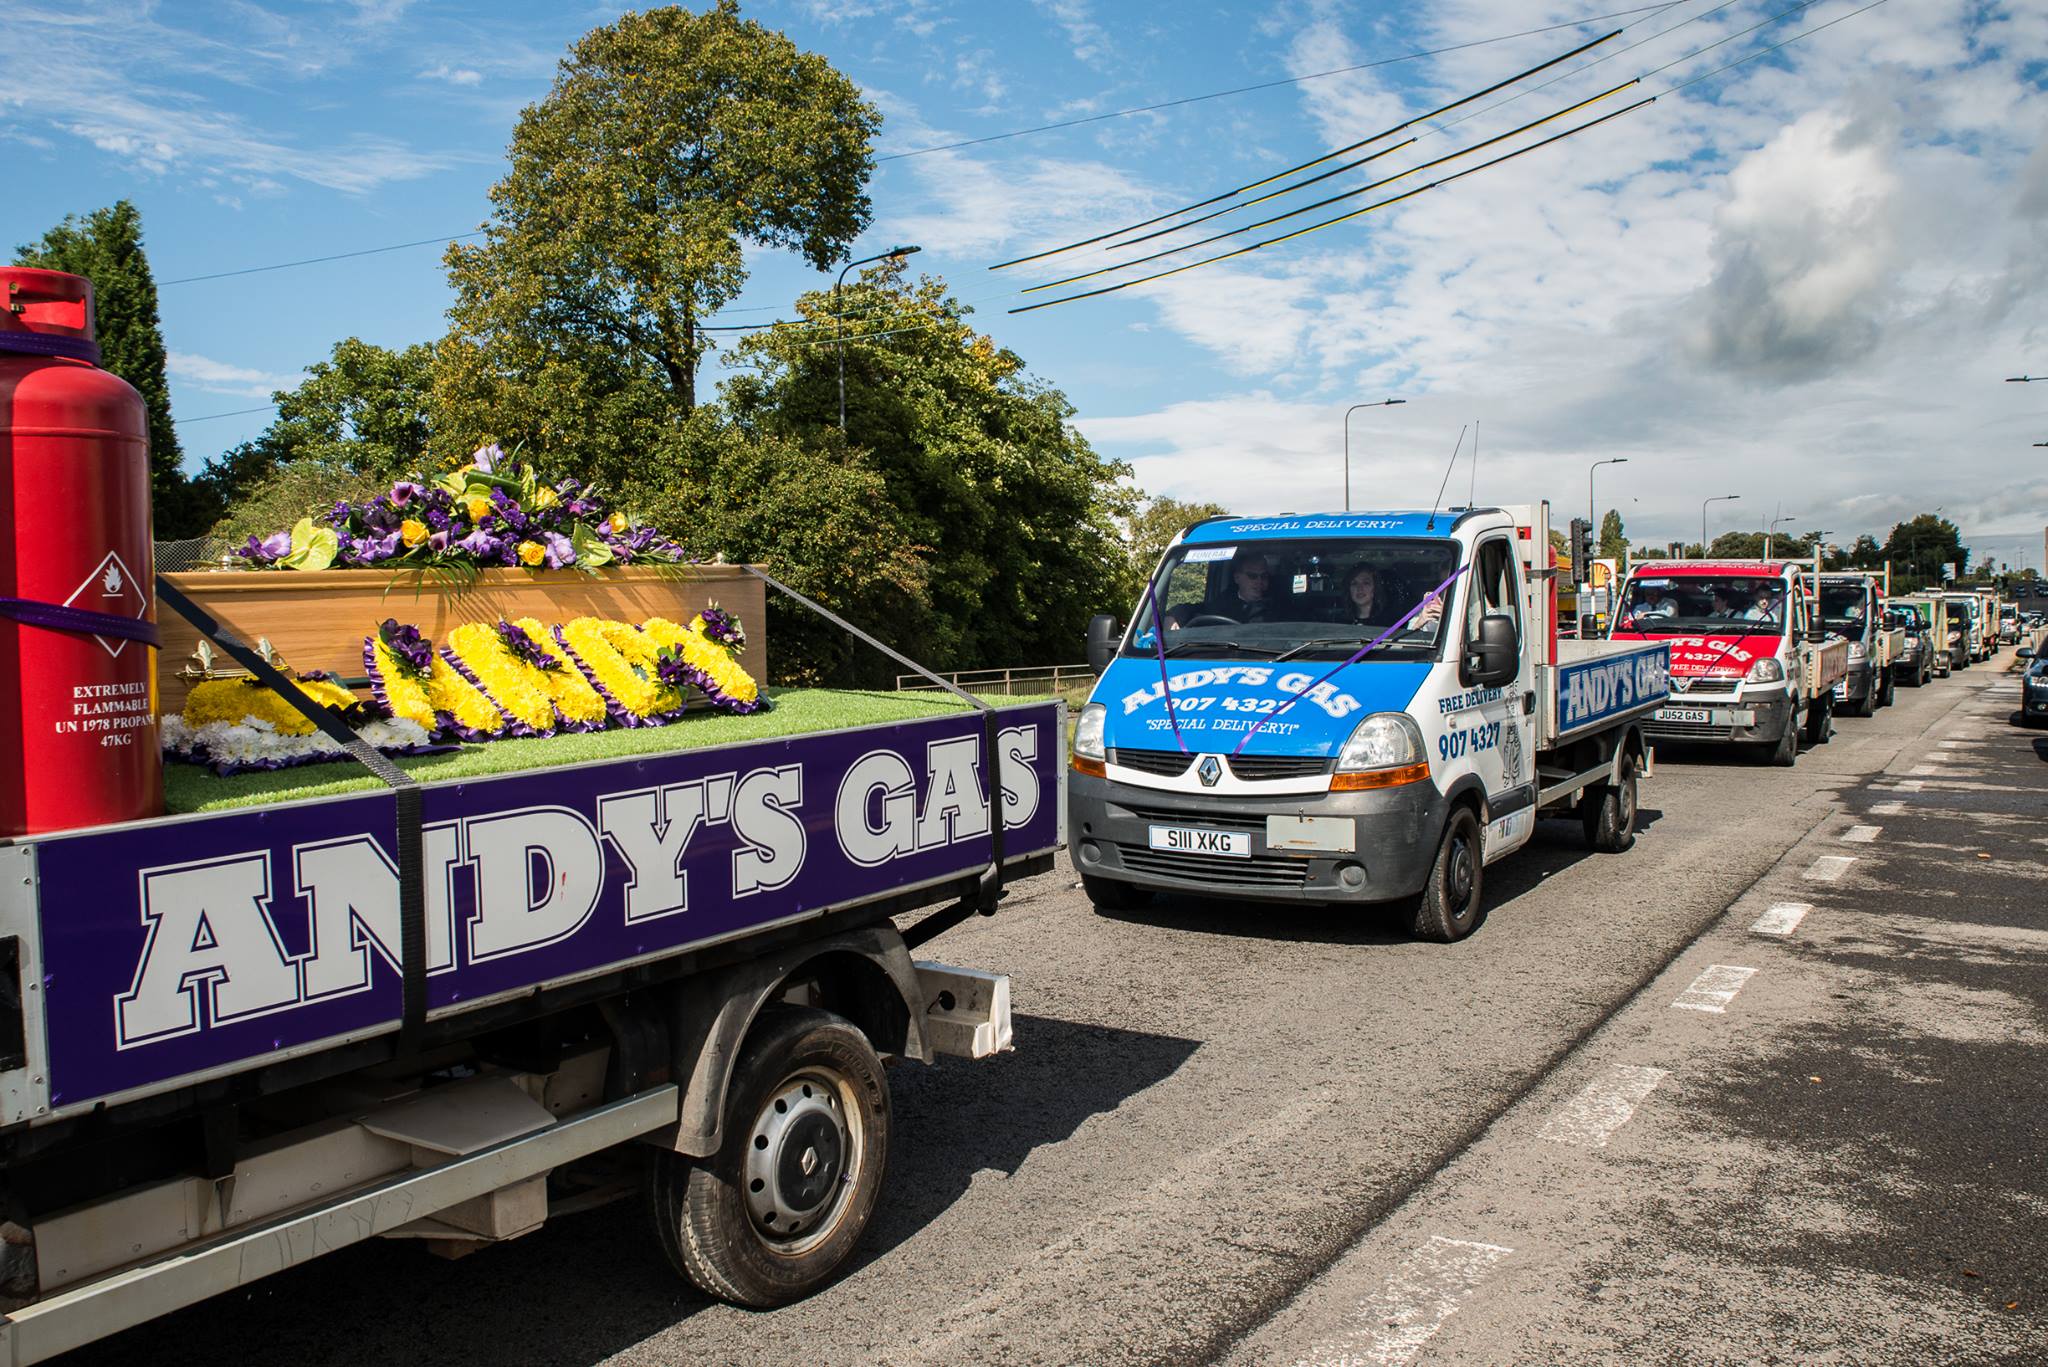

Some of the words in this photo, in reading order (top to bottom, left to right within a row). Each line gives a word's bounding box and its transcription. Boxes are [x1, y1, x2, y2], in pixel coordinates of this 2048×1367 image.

[1230, 521, 1300, 533] "SPECIAL
[1684, 652, 1721, 662] 4327
[1708, 640, 1752, 662] GAS
[73, 682, 146, 699] EXTREMELY
[1121, 667, 1275, 716] ANDY'S
[1276, 672, 1362, 718] GAS
[1566, 659, 1633, 724] ANDY'S
[1635, 651, 1666, 700] GAS
[73, 698, 148, 716] FLAMMABLE
[1164, 697, 1216, 712] 907
[1221, 697, 1296, 715] 4327
[1438, 695, 1463, 714] FREE
[1465, 687, 1502, 706] DELIVERY
[1659, 710, 1683, 720] JU52
[1685, 710, 1704, 720] GAS
[55, 720, 77, 734] UN
[83, 718, 110, 732] 1978
[101, 733, 131, 747] 47KG
[1438, 730, 1467, 762] 907
[1470, 721, 1501, 753] 4327
[1197, 831, 1231, 851] XKG
[115, 764, 806, 1050] ANDY'S
[835, 726, 1037, 867] GAS
